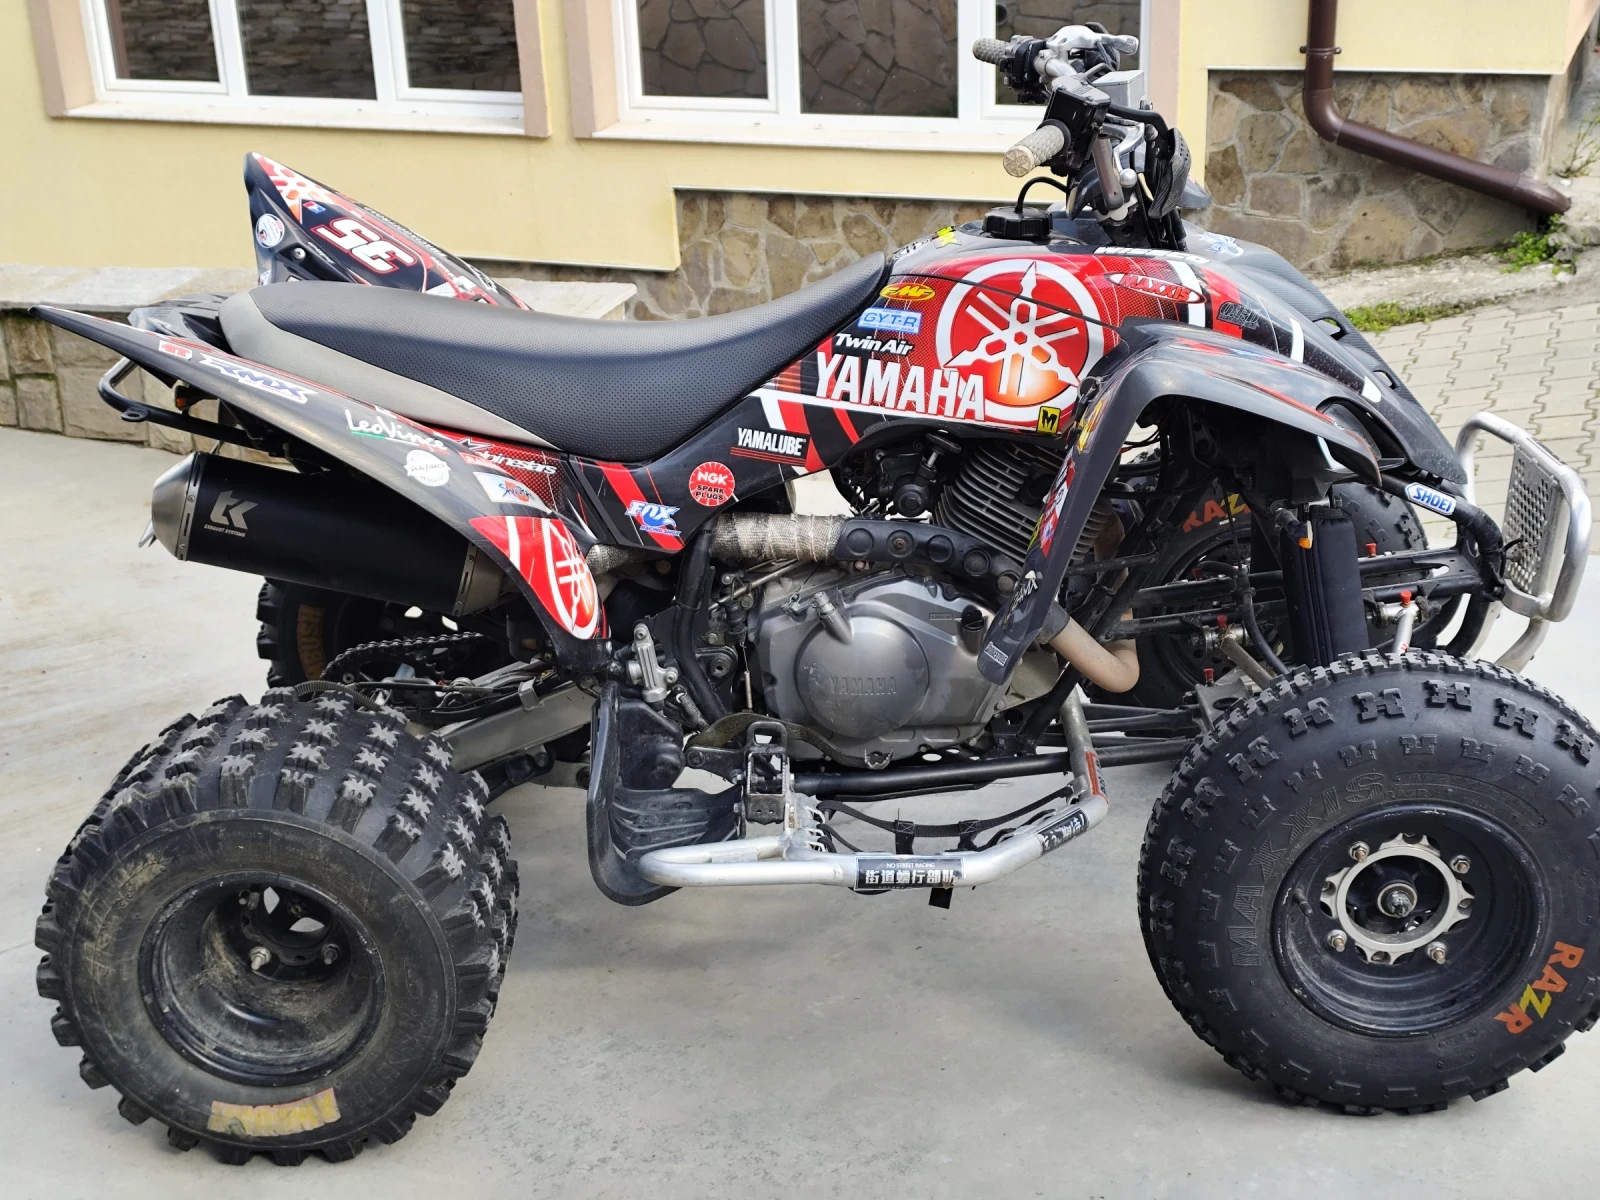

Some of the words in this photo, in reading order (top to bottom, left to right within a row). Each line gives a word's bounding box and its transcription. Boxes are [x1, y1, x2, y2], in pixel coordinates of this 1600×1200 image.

[884, 285, 934, 298] FMF
[1119, 273, 1191, 301] MAXXIS
[835, 333, 882, 351] Twin
[880, 339, 914, 356] Air
[815, 351, 986, 421] YAMAHA
[737, 427, 804, 456] YAMALUBE
[697, 471, 729, 486] NGK
[695, 491, 724, 501] PLUGS
[696, 485, 725, 495] SPARK
[1412, 486, 1455, 514] SHOEI
[625, 500, 681, 520] FOX
[640, 525, 663, 533] RACING
[831, 676, 897, 696] YAMAHA
[1227, 771, 1386, 967] MAXXIS
[1494, 941, 1585, 1034] RAZR
